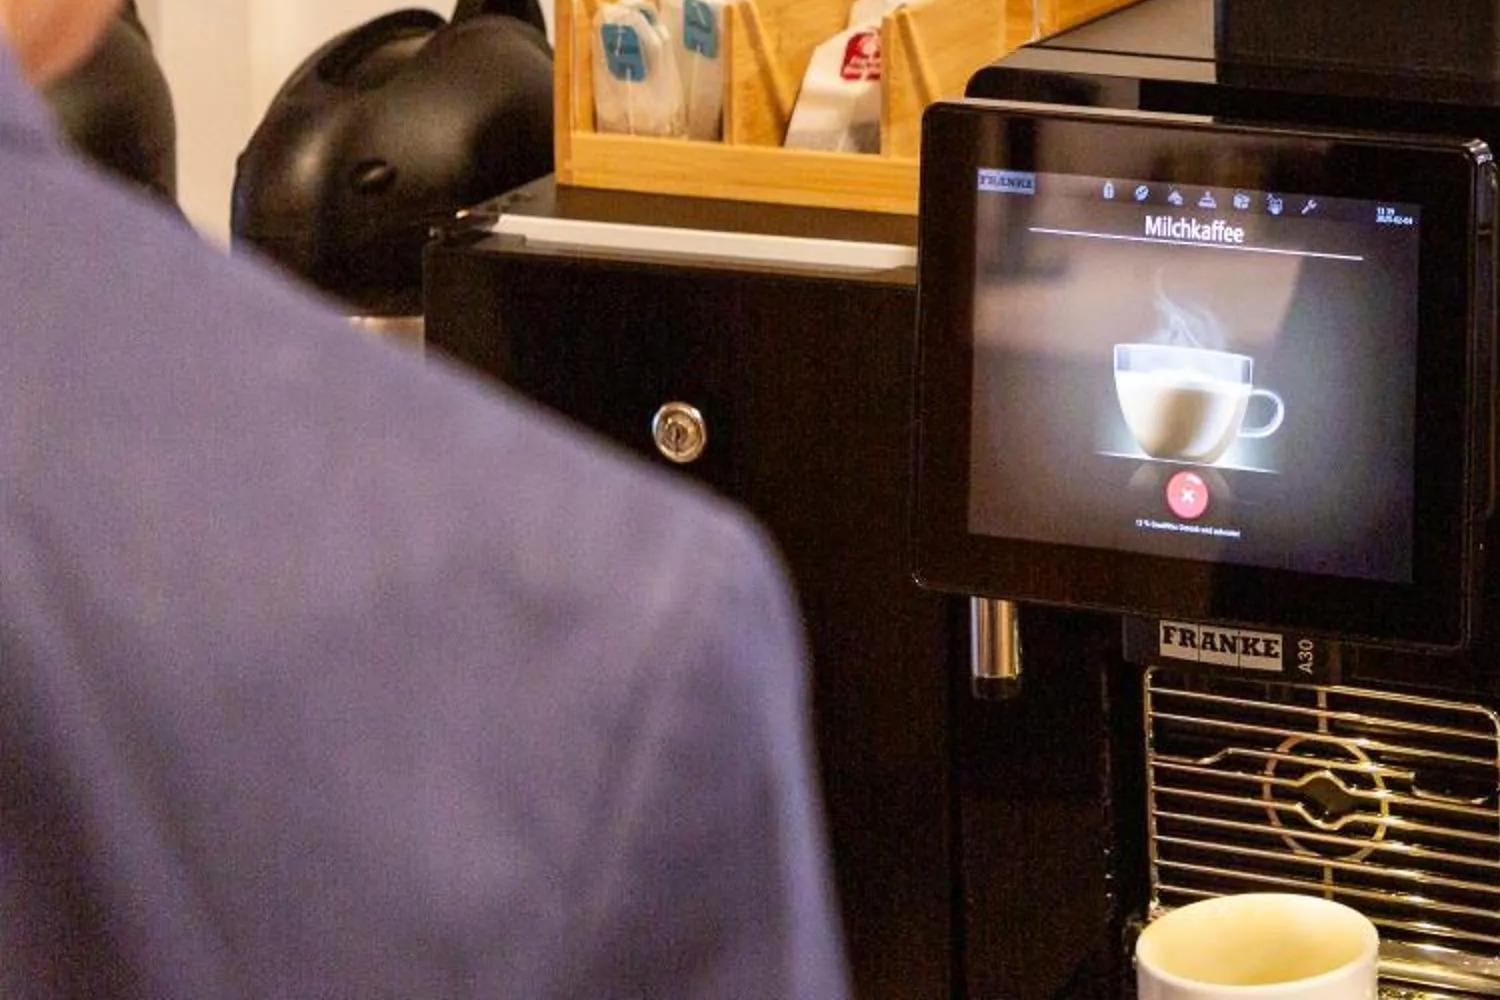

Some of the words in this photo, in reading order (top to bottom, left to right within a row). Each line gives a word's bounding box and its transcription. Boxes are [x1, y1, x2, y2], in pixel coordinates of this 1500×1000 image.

[1145, 215, 1244, 243] Milchkaffee
[1162, 626, 1280, 659] FRANKE
[1298, 639, 1314, 675] A30
